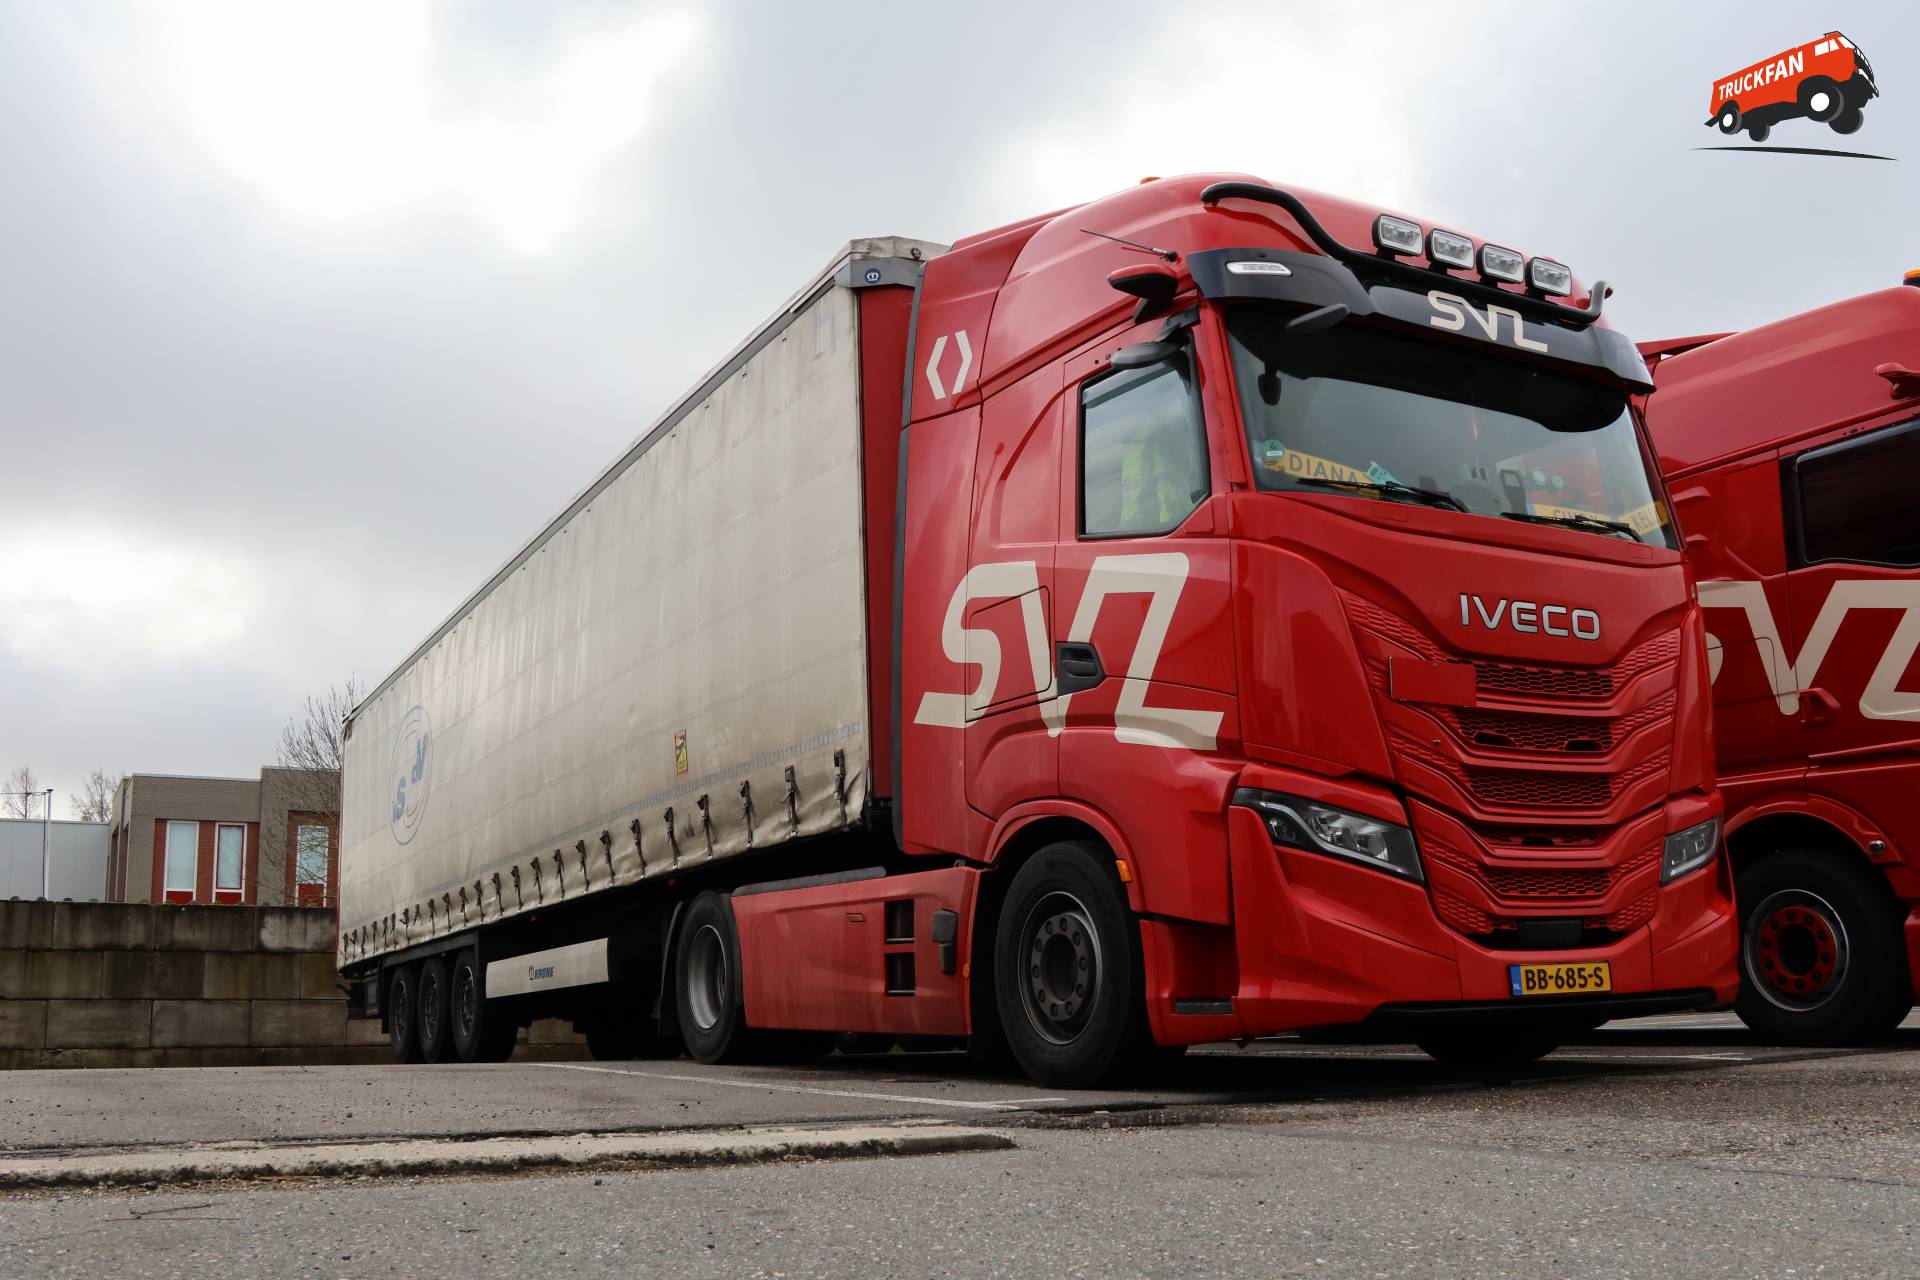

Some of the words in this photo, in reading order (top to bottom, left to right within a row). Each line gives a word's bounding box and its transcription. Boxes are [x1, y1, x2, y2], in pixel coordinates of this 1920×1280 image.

[1290, 453, 1358, 482] DIANA
[1459, 594, 1601, 641] IVECO
[534, 966, 554, 980] KRONE
[1524, 966, 1604, 991] BB-685-S
